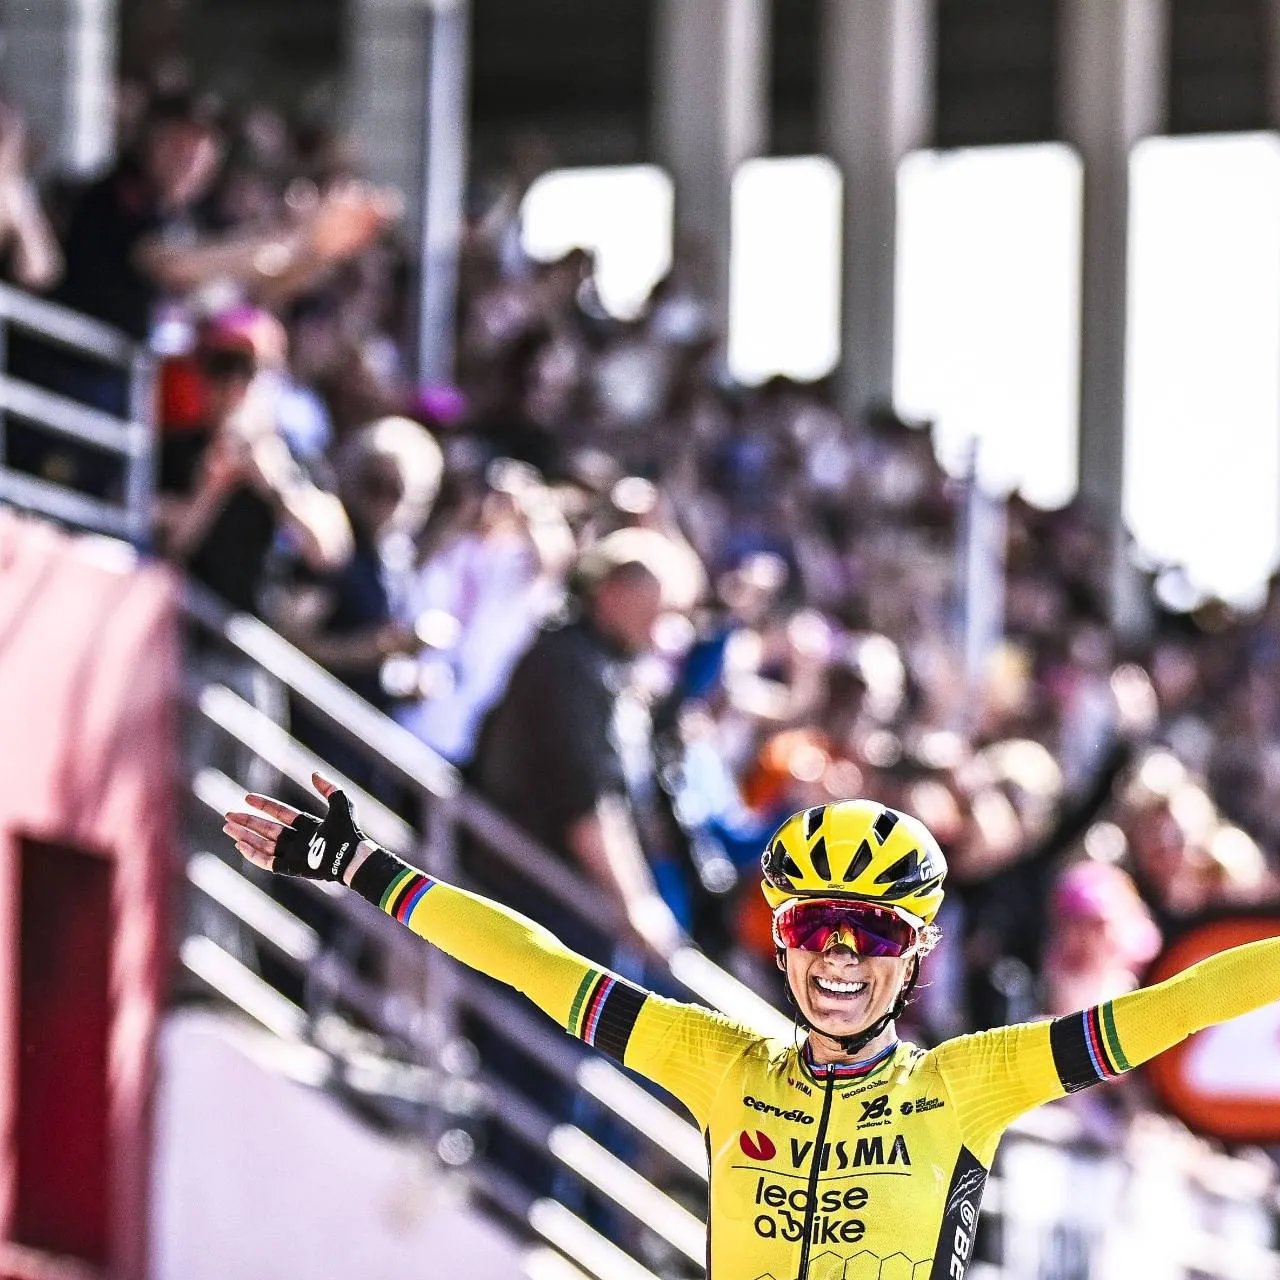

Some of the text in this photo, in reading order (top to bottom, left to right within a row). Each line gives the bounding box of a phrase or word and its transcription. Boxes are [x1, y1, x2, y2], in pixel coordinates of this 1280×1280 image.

[331, 841, 350, 876] GripGrab
[742, 1095, 815, 1125] cervélo
[856, 1120, 883, 1131] yellow
[790, 1134, 912, 1172] VISMA
[755, 1176, 869, 1213] lease
